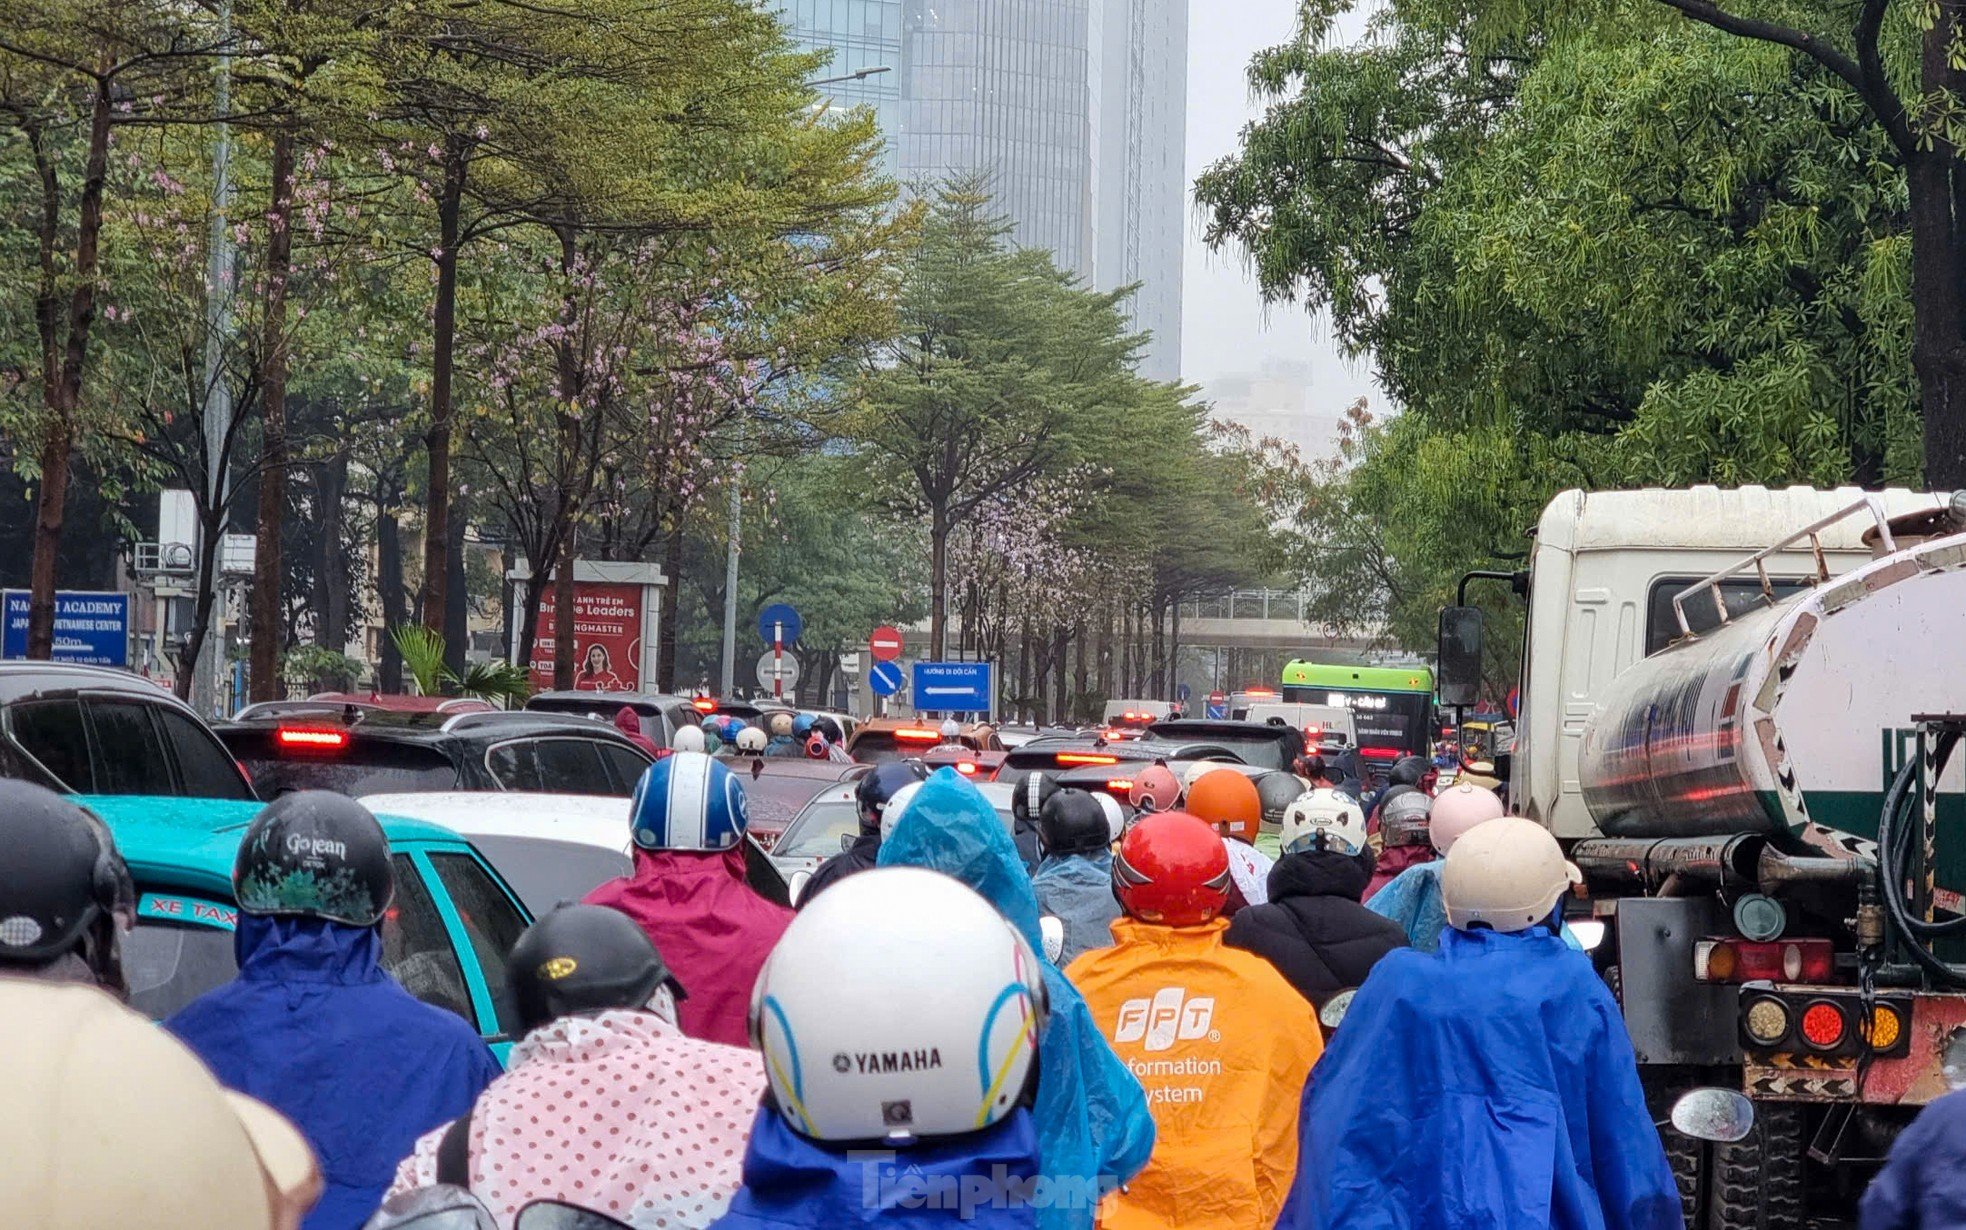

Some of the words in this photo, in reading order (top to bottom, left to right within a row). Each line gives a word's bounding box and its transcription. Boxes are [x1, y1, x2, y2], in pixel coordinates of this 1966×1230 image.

[62, 602, 122, 614] ACADEMY
[587, 604, 635, 617] Leaders
[95, 620, 122, 631] CENTER
[152, 900, 182, 914] XE
[192, 904, 238, 926] TAX
[855, 1048, 942, 1074] YAMAHA
[1127, 1056, 1221, 1075] formation
[1147, 1085, 1203, 1104] ystem
